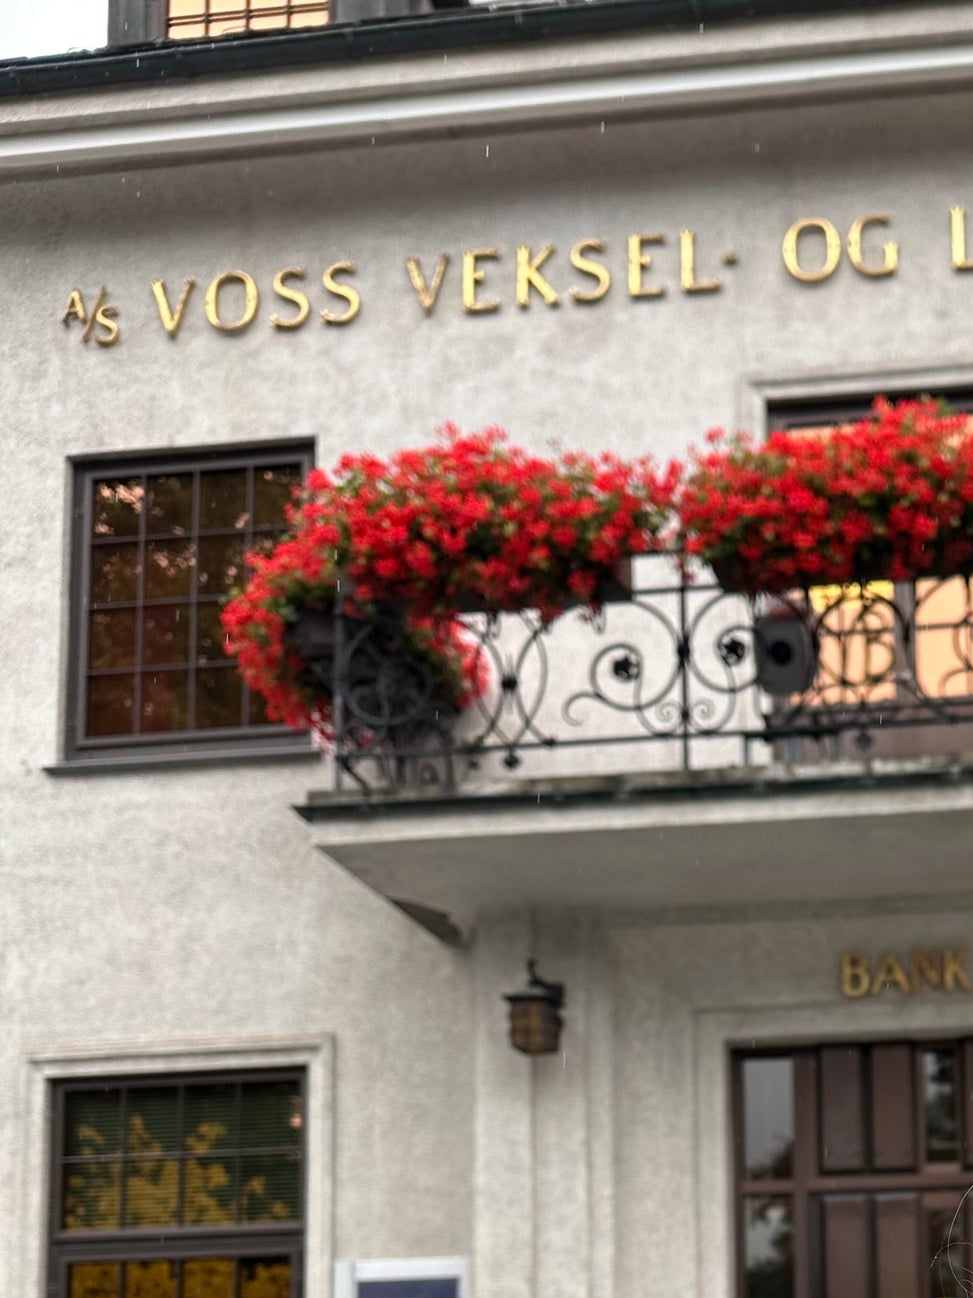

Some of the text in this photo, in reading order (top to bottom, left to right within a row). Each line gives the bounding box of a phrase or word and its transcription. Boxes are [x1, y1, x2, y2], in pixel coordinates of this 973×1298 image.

[62, 286, 120, 346] A/S
[150, 261, 362, 338] VOSS
[782, 214, 899, 282] OG
[840, 947, 973, 998] BANK
